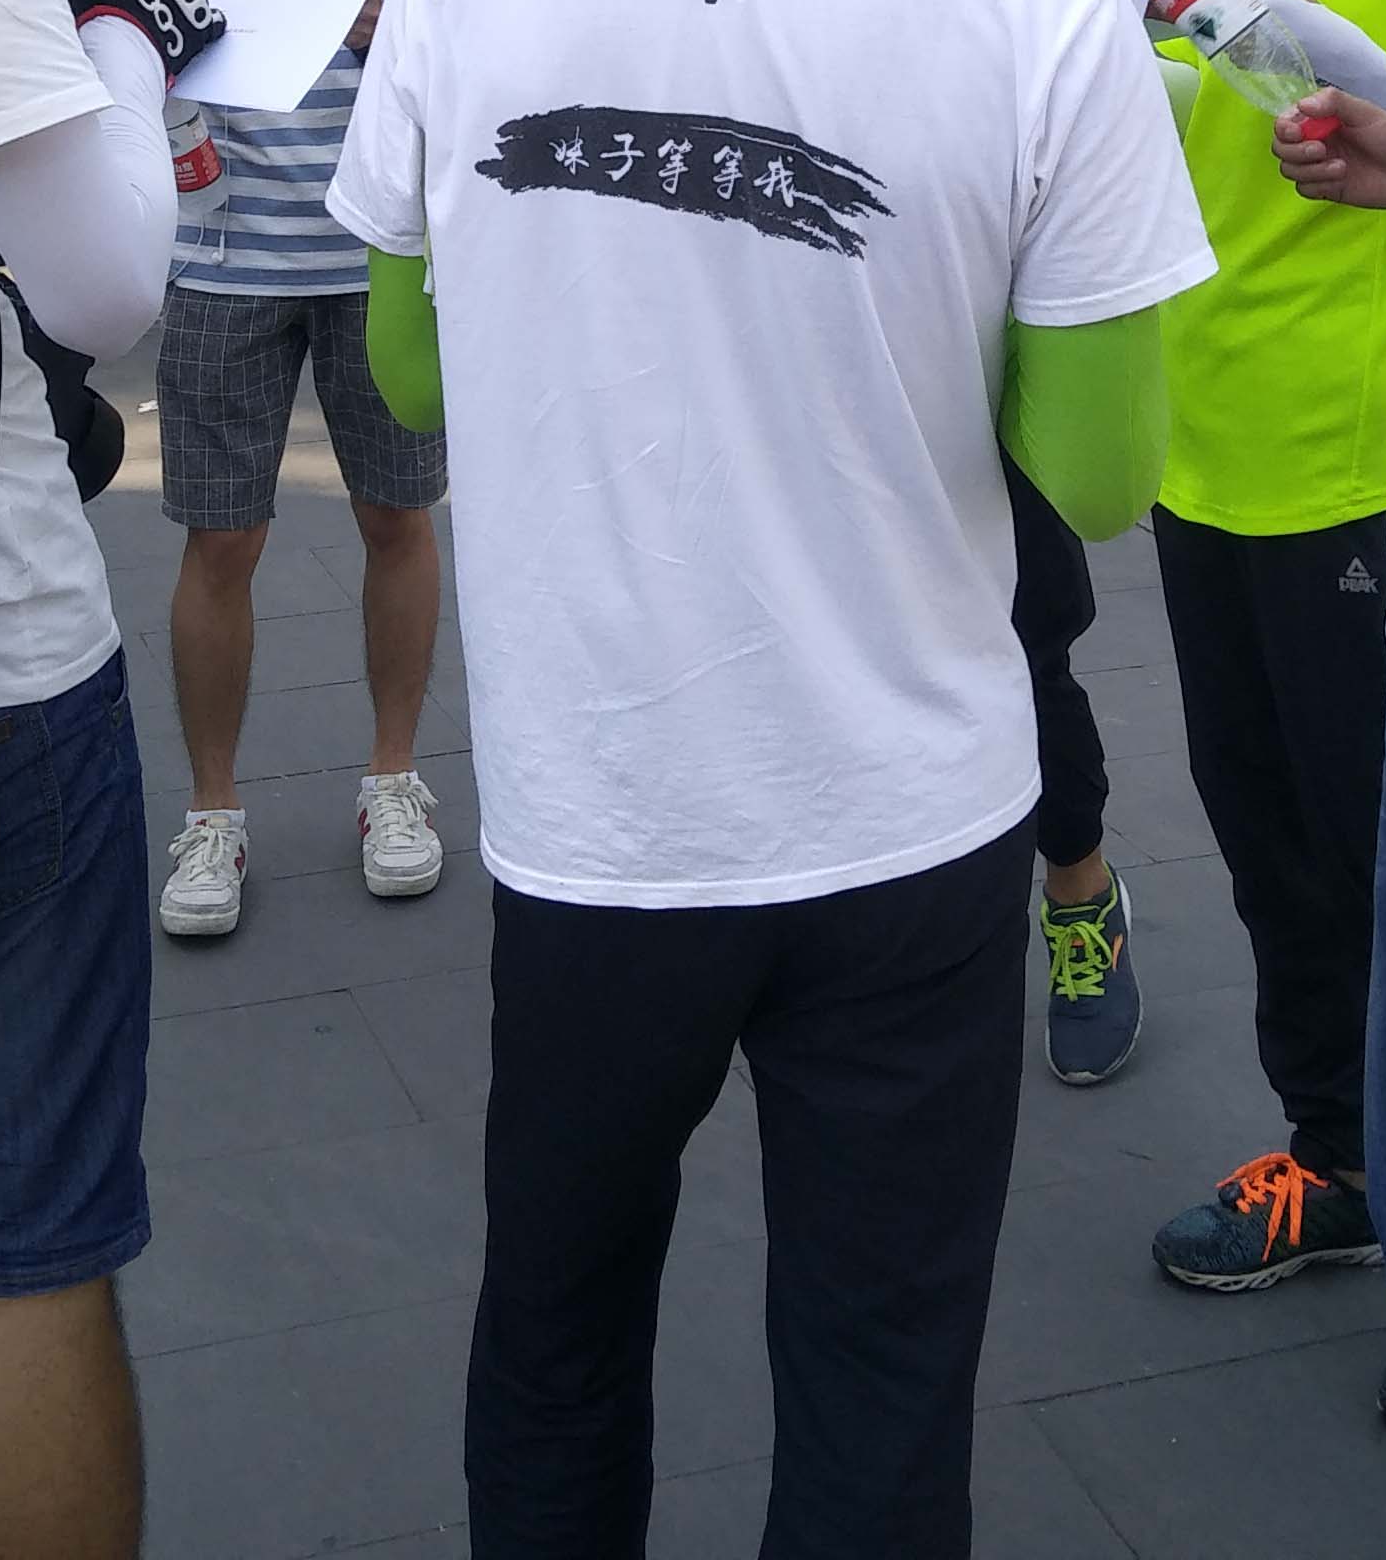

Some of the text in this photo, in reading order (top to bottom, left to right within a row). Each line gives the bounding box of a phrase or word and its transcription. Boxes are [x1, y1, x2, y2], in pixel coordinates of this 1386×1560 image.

[548, 126, 797, 209] 妹子等等我
